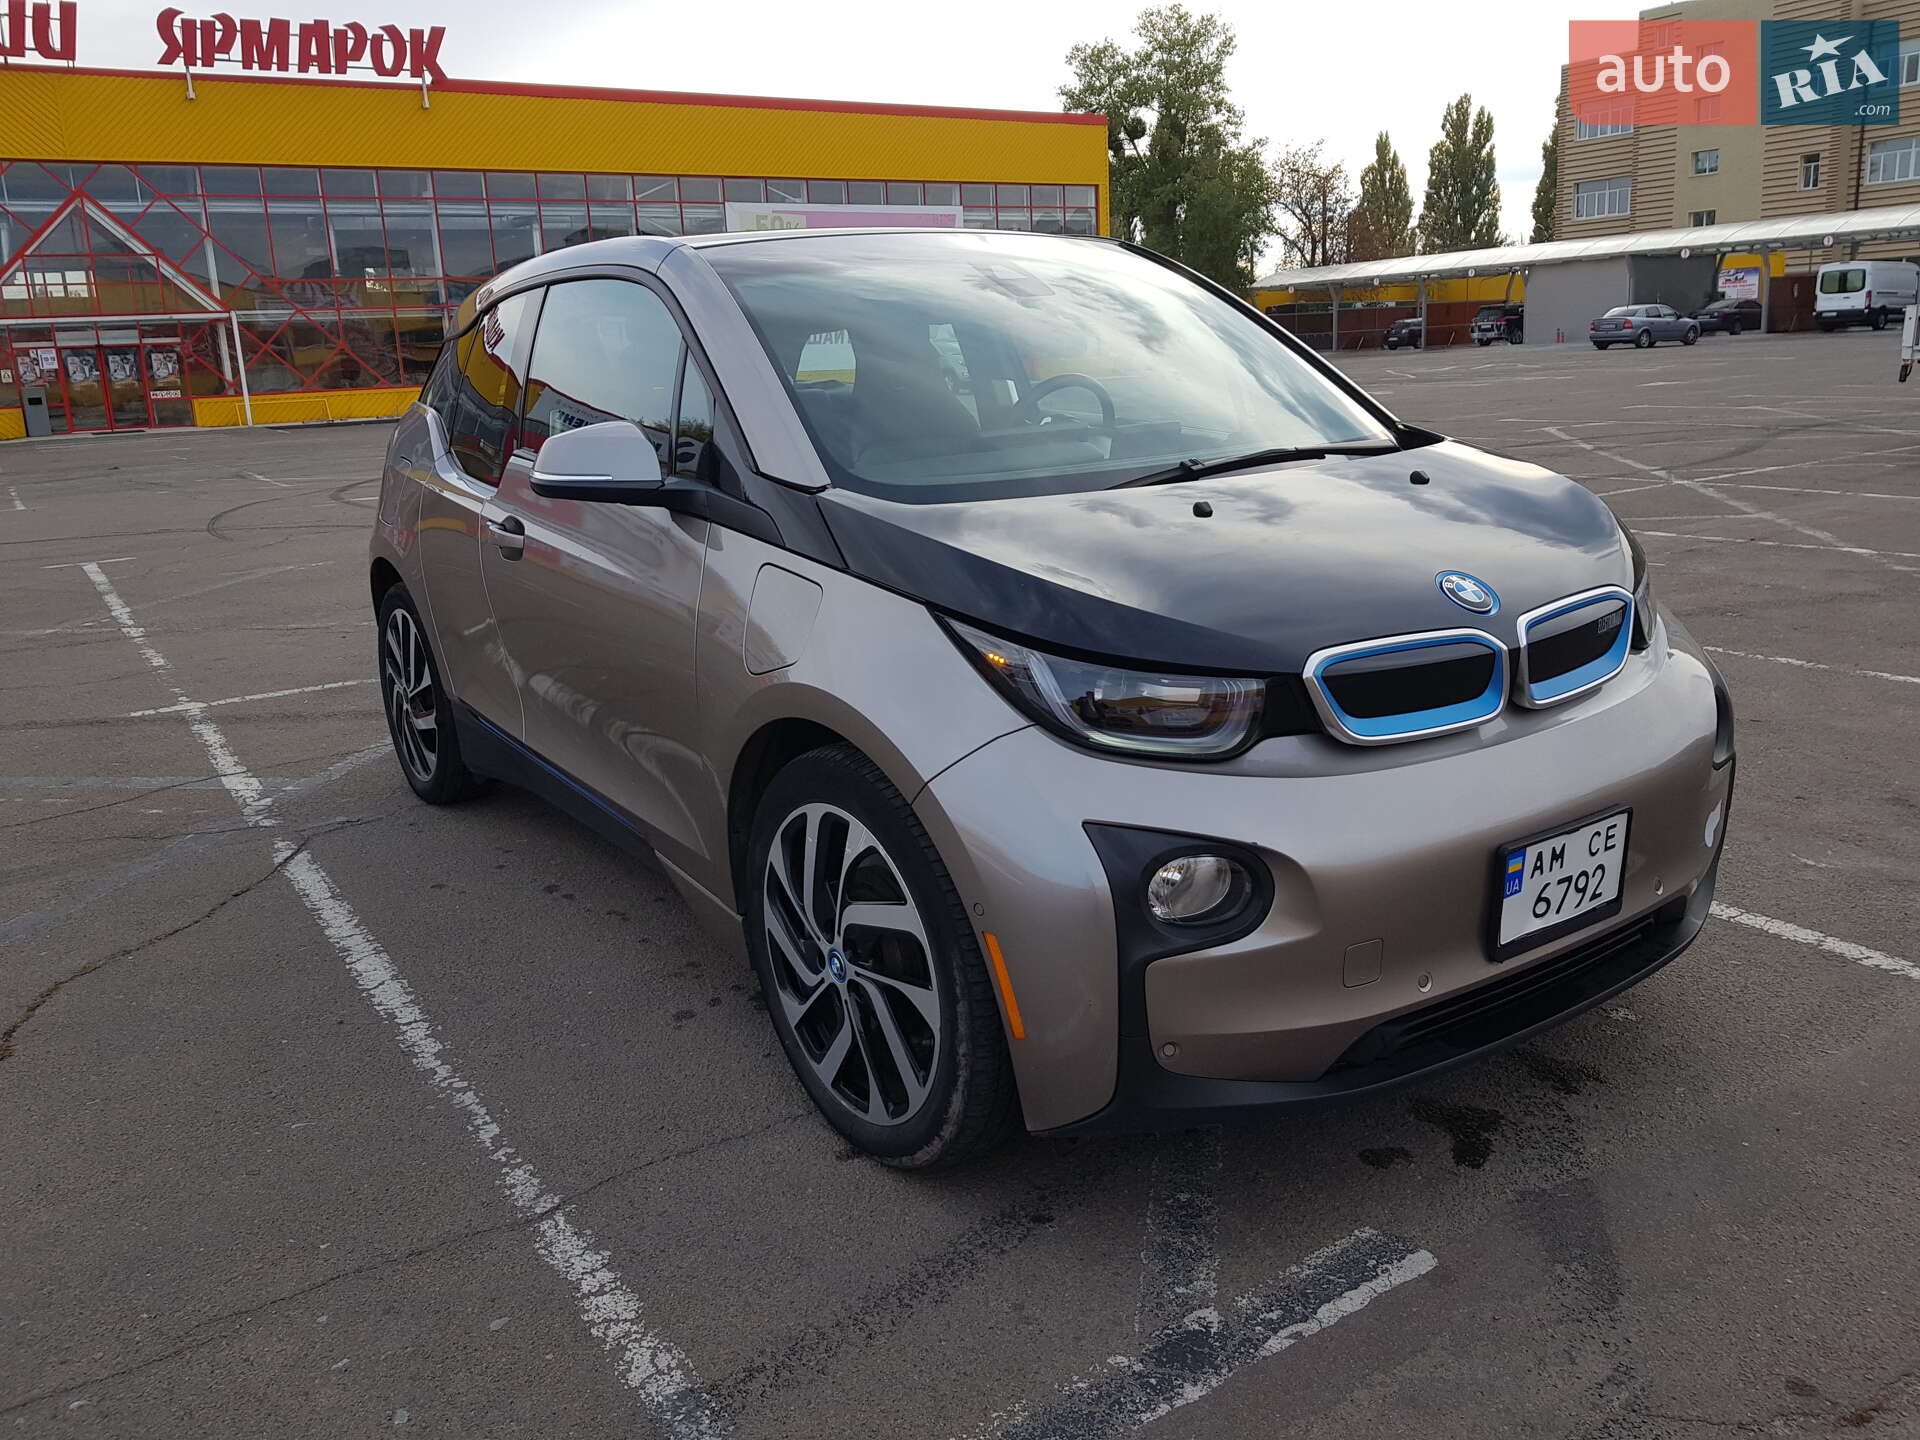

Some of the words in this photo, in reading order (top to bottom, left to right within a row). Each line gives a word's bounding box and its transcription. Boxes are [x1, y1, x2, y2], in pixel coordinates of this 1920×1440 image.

[157, 7, 447, 83] ЯРМАРОК
[1530, 842, 1566, 879] AM
[1588, 823, 1618, 857] CE
[1506, 878, 1520, 895] UA
[1532, 863, 1606, 919] 6792
